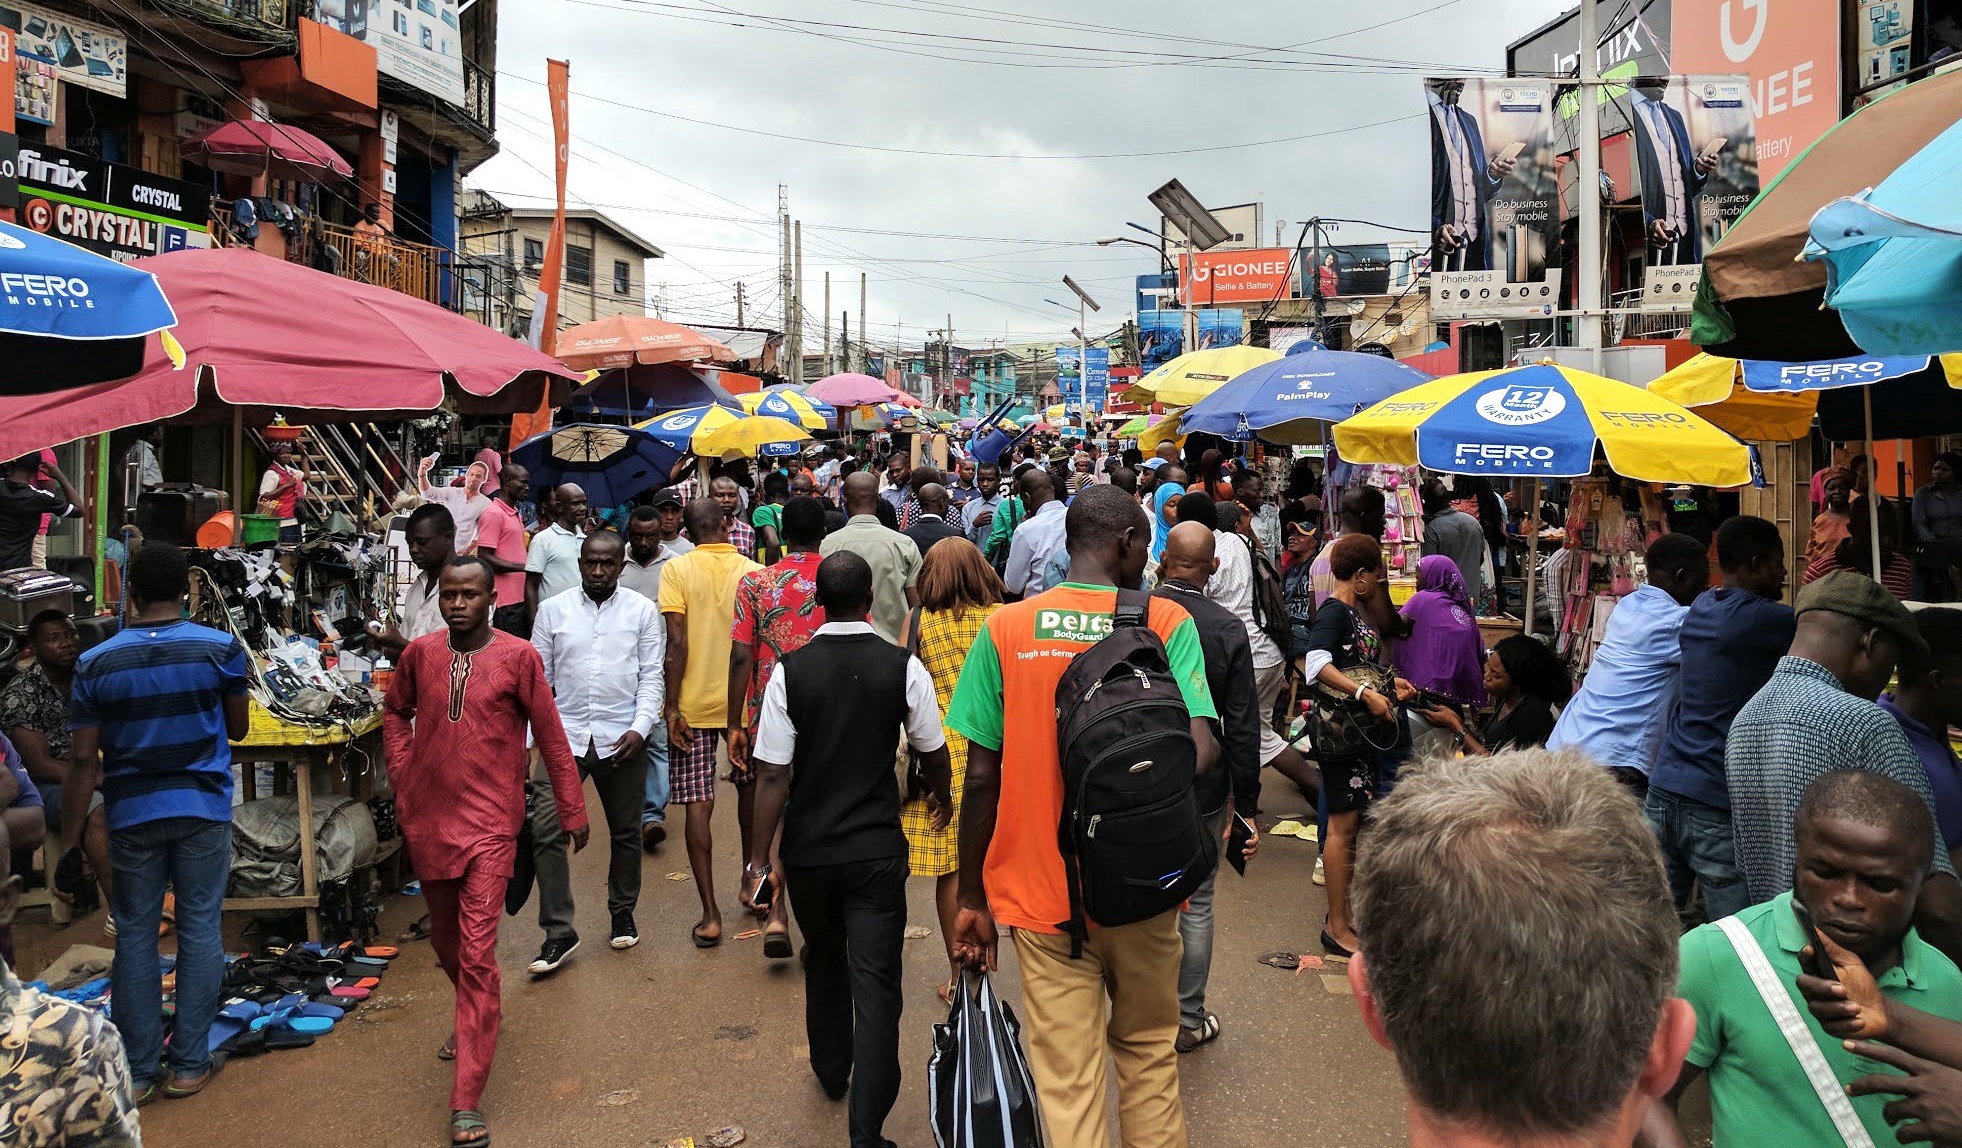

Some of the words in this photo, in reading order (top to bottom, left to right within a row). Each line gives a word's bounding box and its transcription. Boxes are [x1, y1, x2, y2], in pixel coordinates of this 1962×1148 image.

[1751, 60, 1814, 119] NEE
[1756, 135, 1793, 162] attery
[132, 184, 183, 212] CRYSTAL
[1495, 199, 1509, 209] Do
[1510, 198, 1548, 209] business
[1701, 194, 1716, 204] Do
[1495, 211, 1516, 222] Stay
[1517, 210, 1549, 221] mobile
[1703, 206, 1720, 217] Stay
[1720, 206, 1747, 216] mobil
[56, 203, 156, 251] CRYSTAL
[1214, 260, 1287, 278] GIONEE
[1655, 267, 1695, 278] PhonePad
[1696, 267, 1702, 276] 3
[1, 272, 90, 298] FERO
[1441, 273, 1484, 284] PhonePad
[1487, 273, 1493, 282] 3
[1214, 282, 1237, 292] Selfie
[1238, 283, 1244, 291] &
[1246, 281, 1275, 292] Battery
[8, 295, 96, 309] MOBILE
[1296, 371, 1336, 379] DOWNLOADS
[1781, 361, 1884, 379] FERO
[1781, 371, 1883, 385] MOBILE
[1276, 391, 1332, 401] PalmPlay
[1507, 390, 1544, 405] 12
[1376, 401, 1439, 413] FERO
[1504, 401, 1538, 410] Month
[1483, 403, 1552, 422] WARRANTY
[1600, 410, 1687, 423] FERO
[1612, 422, 1697, 430] MOBILE
[1456, 443, 1554, 460] FERO
[1455, 458, 1554, 468] MOBILE
[1041, 611, 1115, 634] Delta
[1053, 629, 1103, 642] BodyGuard
[1017, 649, 1038, 660] Tough
[1040, 649, 1050, 657] on
